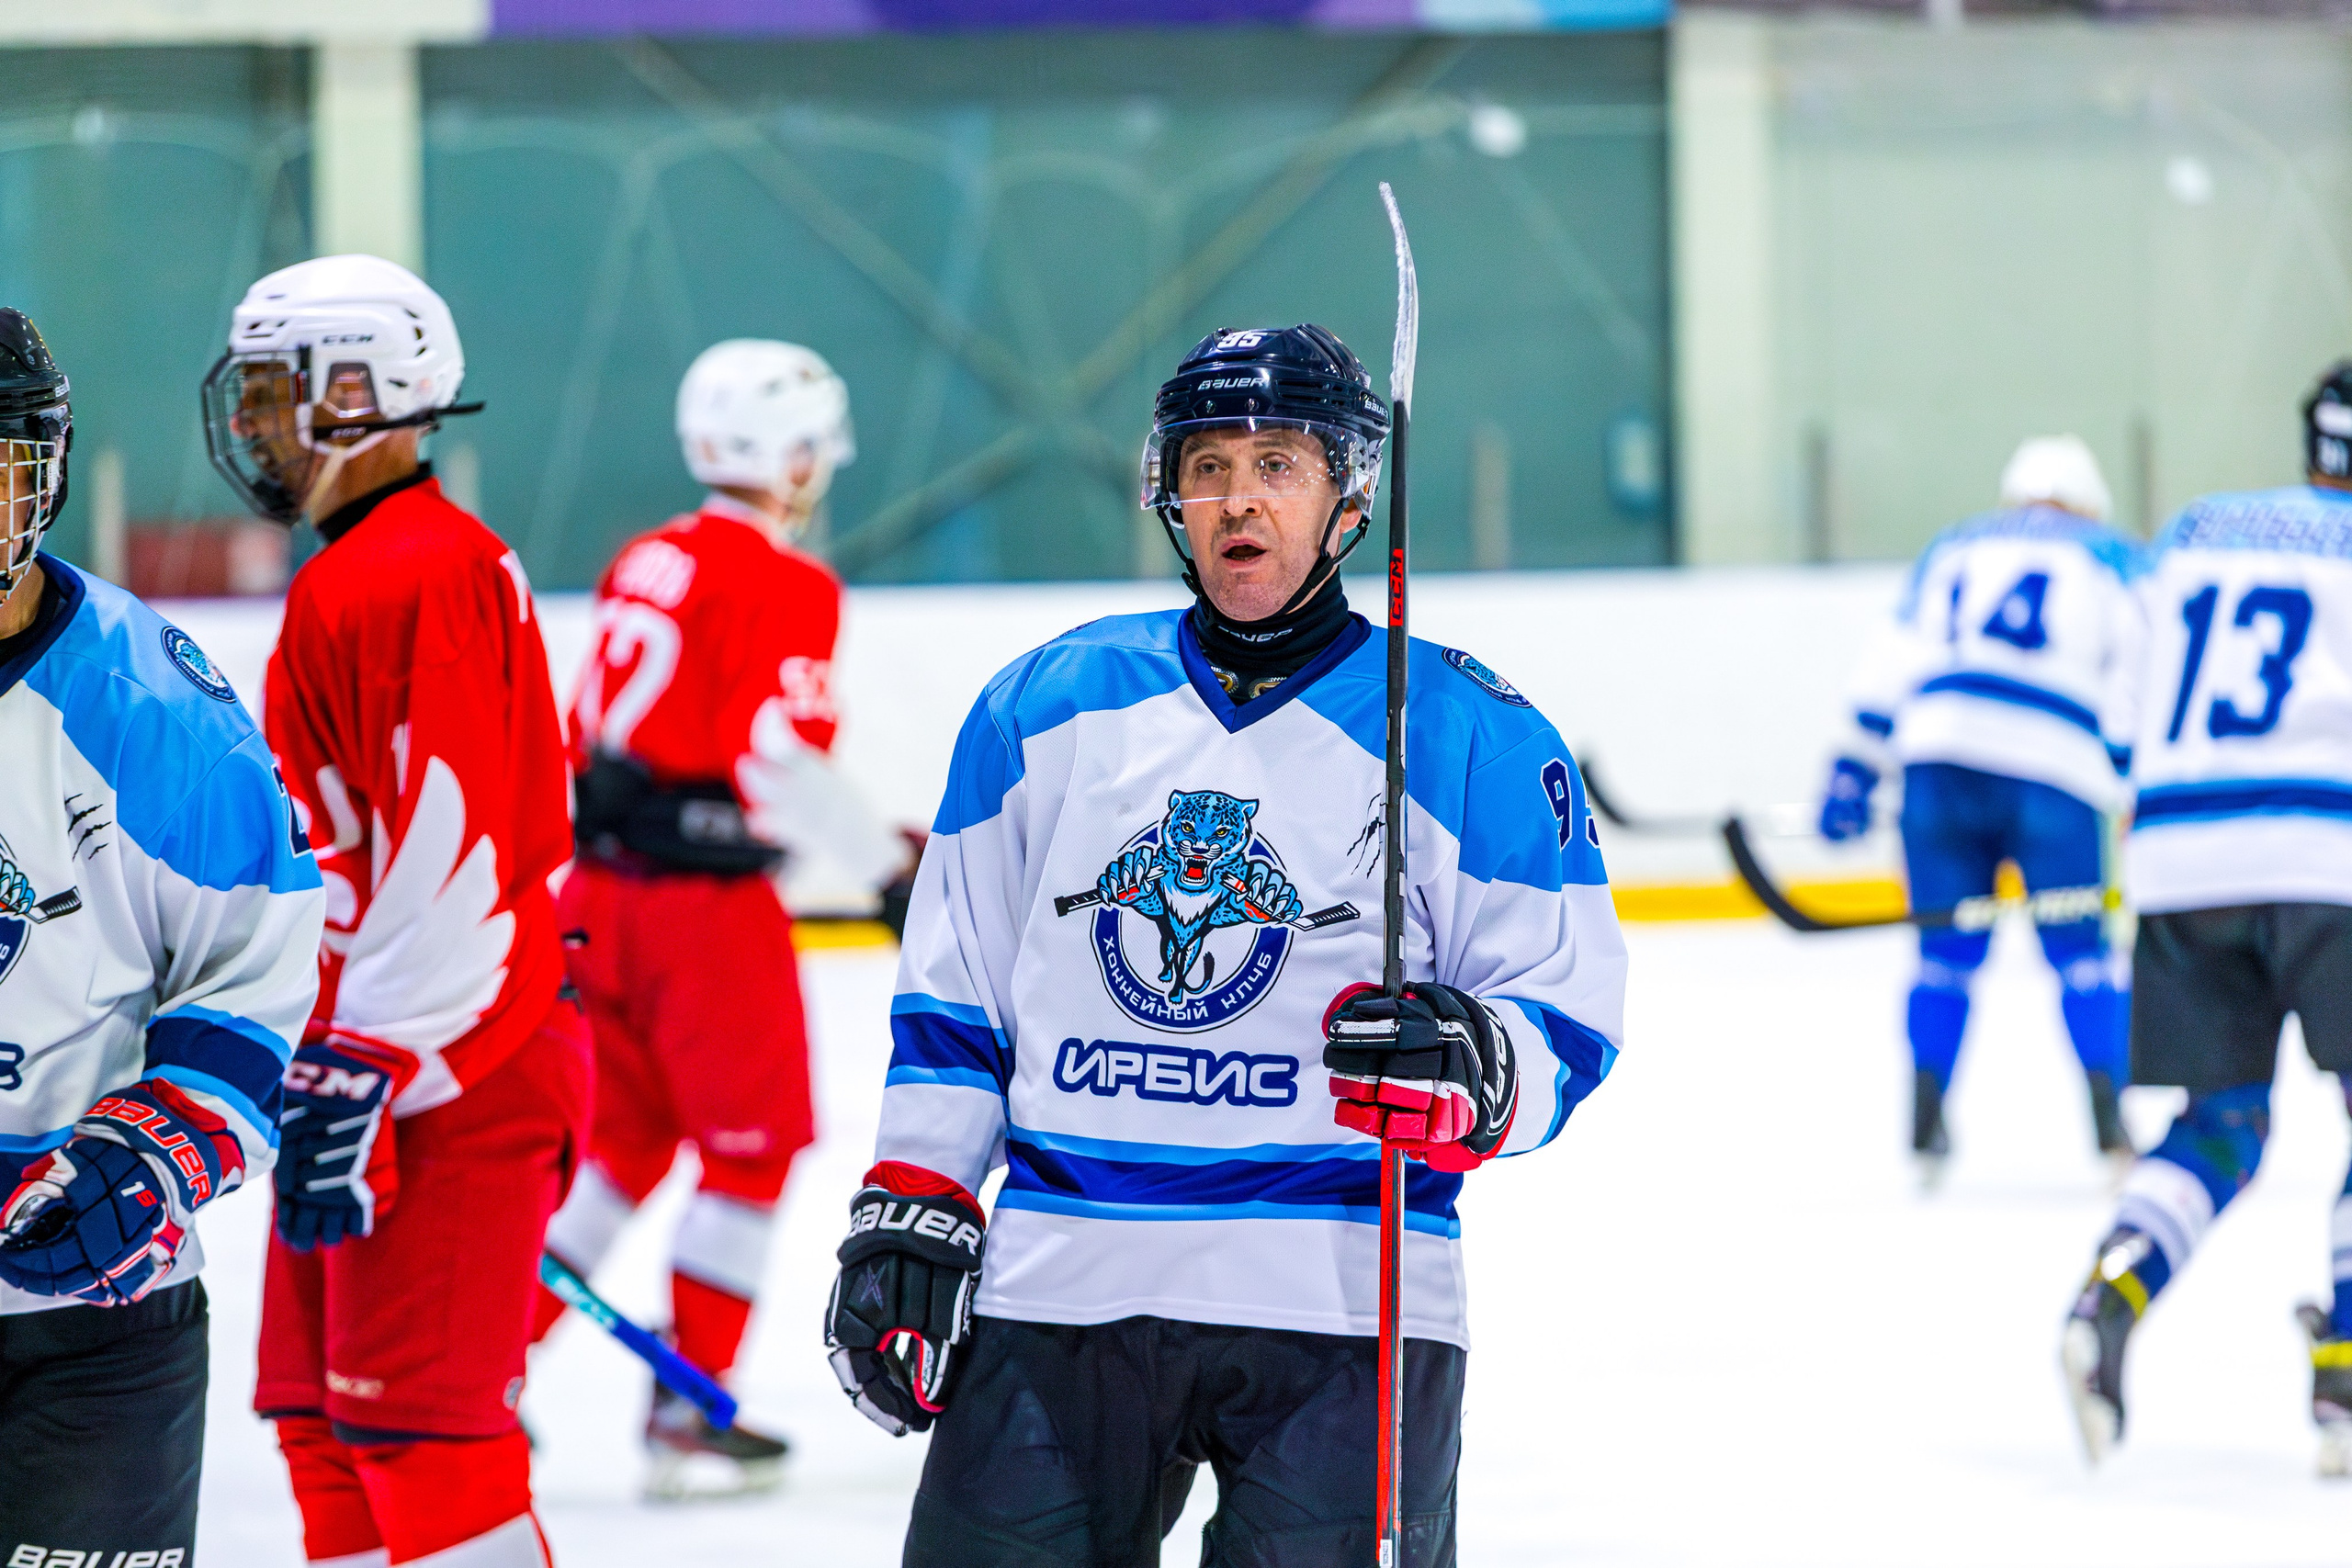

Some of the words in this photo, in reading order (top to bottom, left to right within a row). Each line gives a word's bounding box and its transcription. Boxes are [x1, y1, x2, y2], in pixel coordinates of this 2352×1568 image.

[1216, 331, 1269, 349] 95
[1197, 377, 1269, 391] BAUER
[1391, 557, 1402, 620] CCM
[1947, 566, 2050, 649] 14
[2165, 582, 2315, 745] 13
[1102, 935, 1209, 1021] ХОККЕЙНЫЙ
[1058, 1043, 1294, 1101] ИРБИС
[83, 1097, 212, 1210] BAUER
[848, 1201, 981, 1257] BAUER
